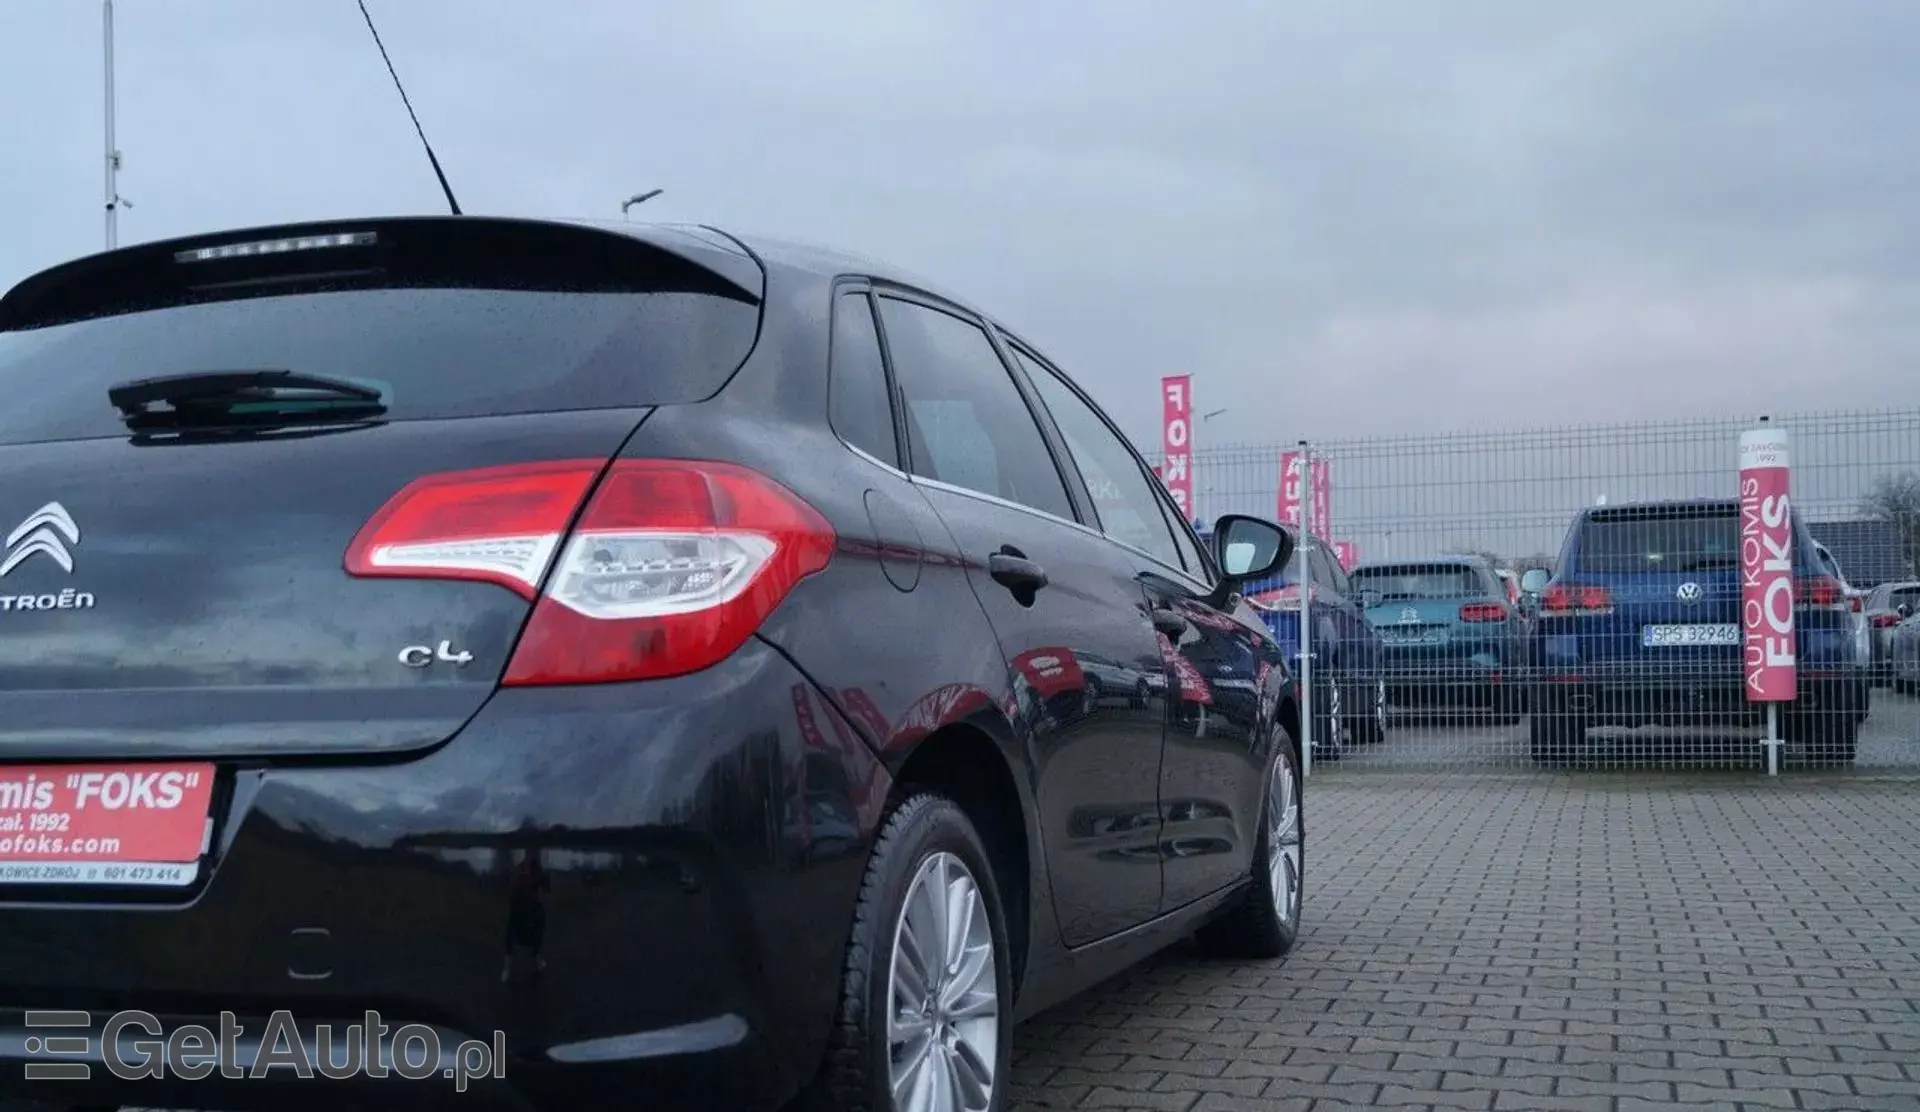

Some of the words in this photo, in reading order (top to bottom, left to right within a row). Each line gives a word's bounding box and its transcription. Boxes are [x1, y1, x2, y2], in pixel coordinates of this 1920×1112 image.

[1741, 477, 1761, 588] KOMIS
[1761, 493, 1796, 667] FOKS
[398, 639, 474, 668] C4
[1744, 599, 1765, 694] AUTO
[29, 812, 71, 832] 1992
[66, 771, 200, 810] "FOKS"
